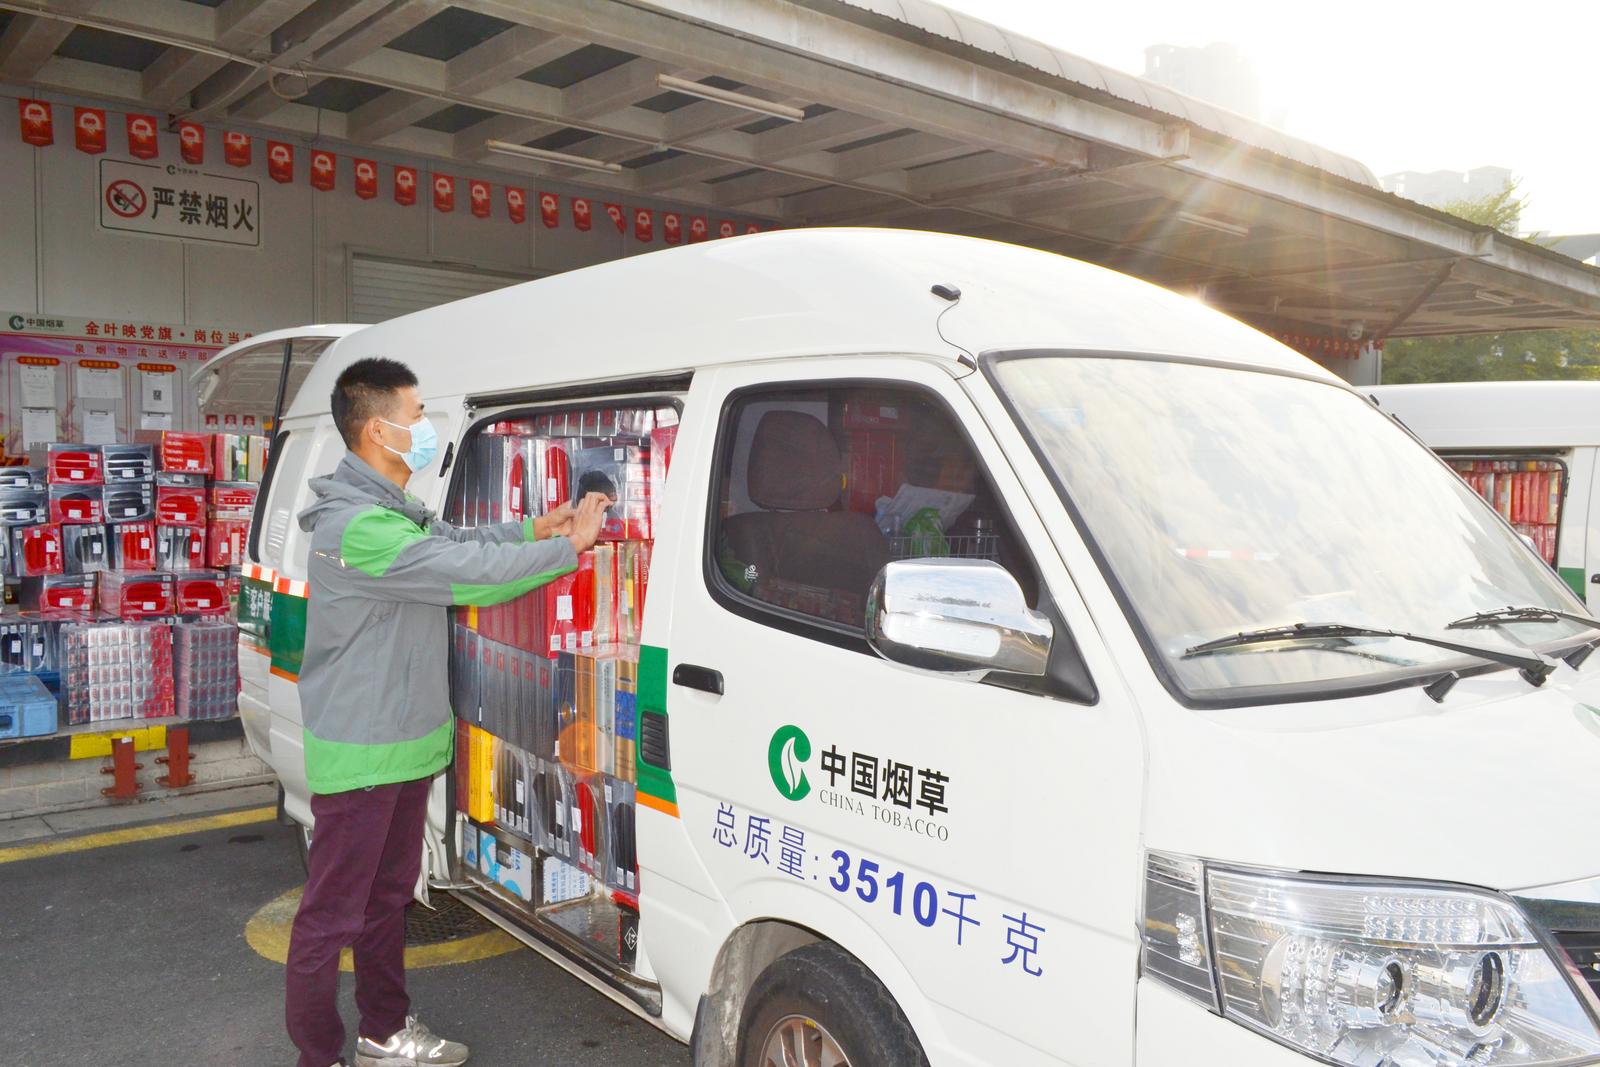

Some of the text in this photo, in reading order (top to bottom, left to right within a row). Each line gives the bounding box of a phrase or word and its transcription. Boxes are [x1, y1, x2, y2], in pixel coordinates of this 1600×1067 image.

[152, 187, 254, 232] 严禁烟火
[26, 318, 64, 328] 中国烟草
[820, 744, 950, 817] 中国烟草
[819, 788, 949, 842] CHINA TOBACCO
